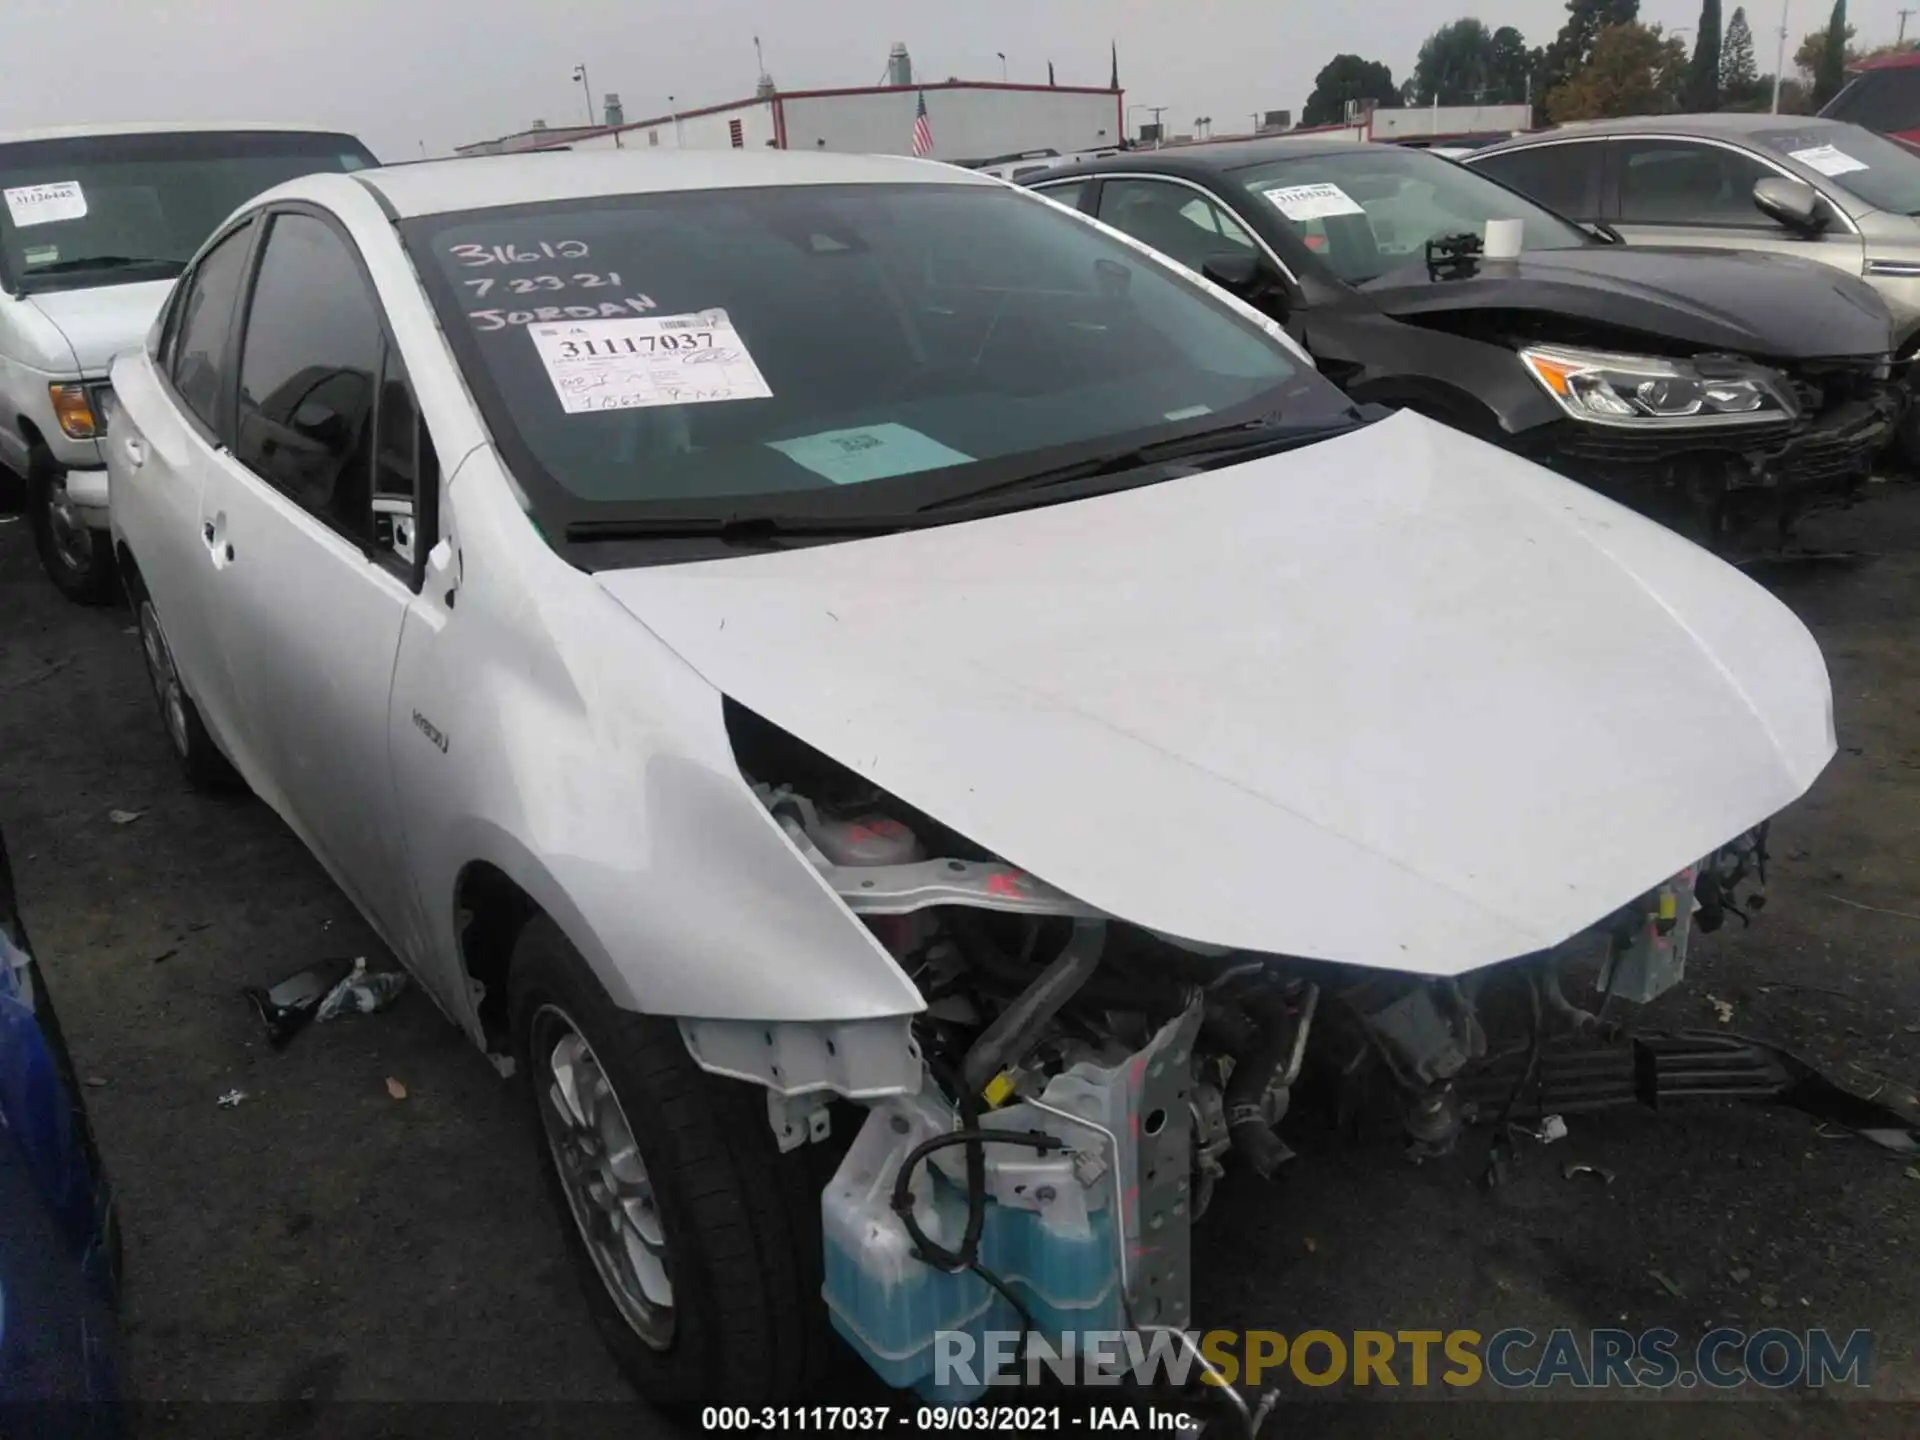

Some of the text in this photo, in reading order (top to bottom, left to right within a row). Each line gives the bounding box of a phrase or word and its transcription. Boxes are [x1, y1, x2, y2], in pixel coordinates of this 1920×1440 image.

[450, 240, 589, 267] 31612
[468, 293, 657, 332] JORDAN
[559, 332, 714, 359] 31117037
